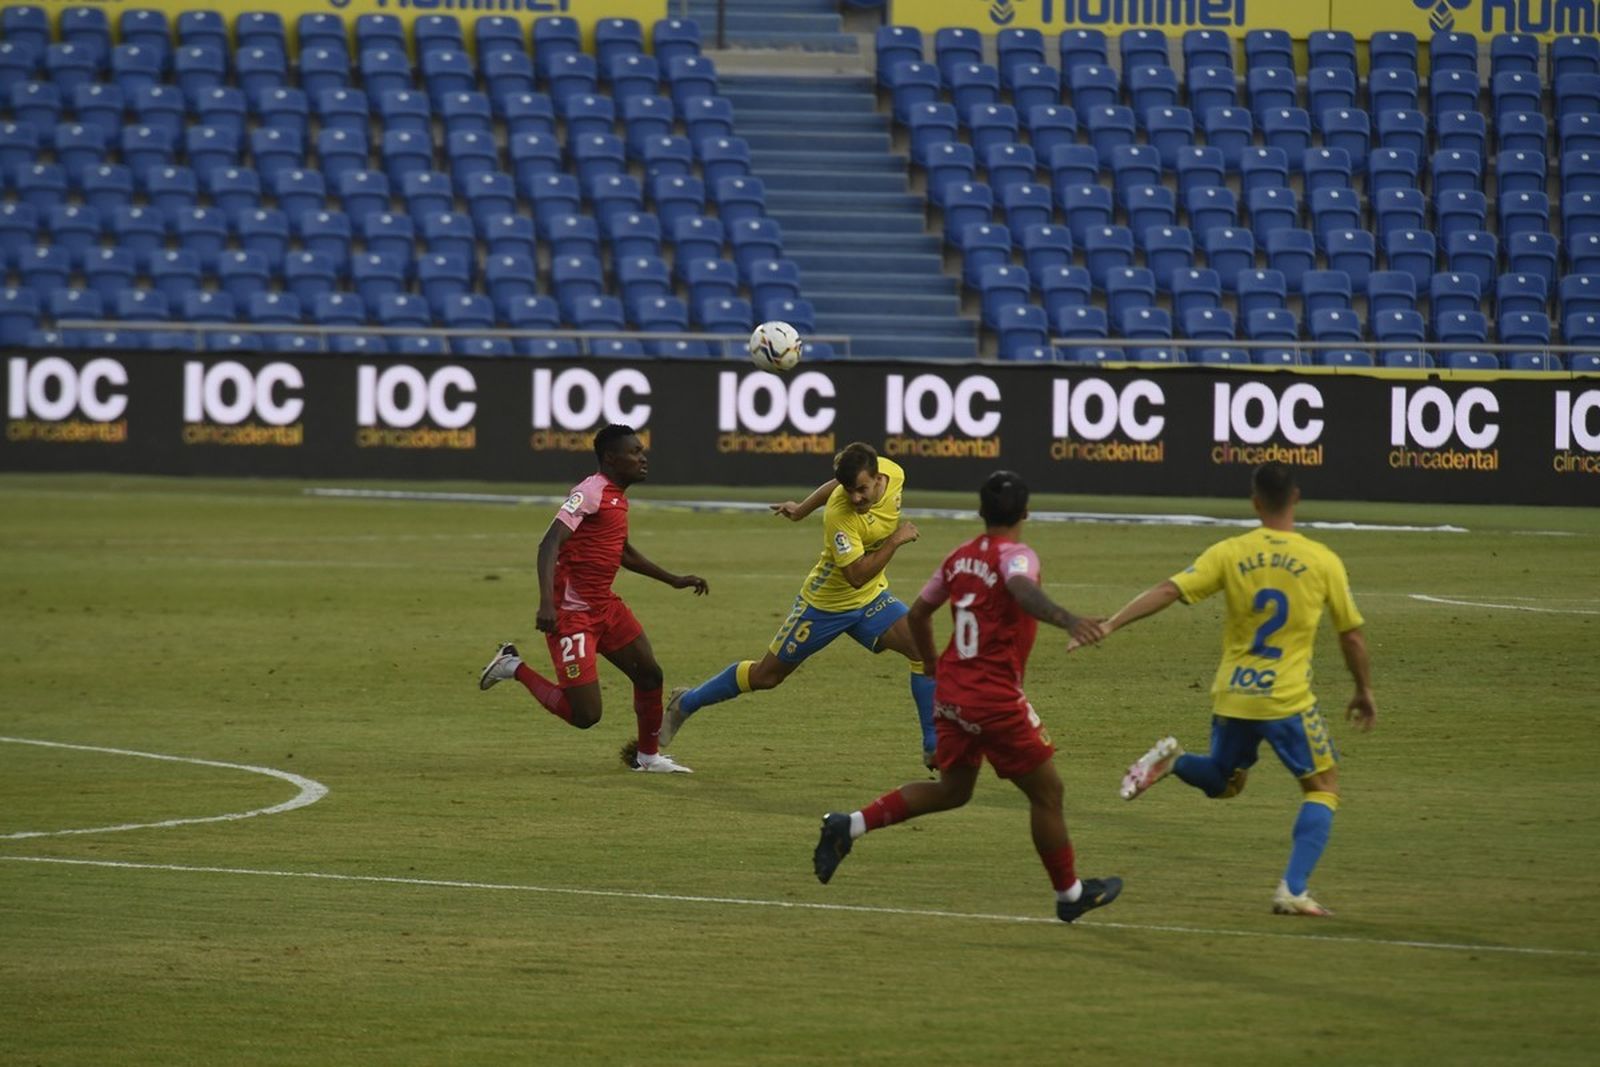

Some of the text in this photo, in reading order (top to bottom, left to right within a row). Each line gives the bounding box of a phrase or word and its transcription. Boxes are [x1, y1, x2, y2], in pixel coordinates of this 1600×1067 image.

[1481, 0, 1600, 34] hum
[9, 358, 127, 421] IOC
[184, 362, 303, 425] IOC
[358, 365, 476, 428] IOC
[532, 368, 651, 431] IOC
[719, 371, 836, 434] IOC
[886, 374, 1001, 437] IOC
[1053, 378, 1165, 440] IOC
[1214, 382, 1324, 445] IOC
[1391, 386, 1499, 449] IOC
[1212, 443, 1323, 465] clinicadental
[1389, 448, 1498, 470] clinicadental
[1238, 552, 1266, 576] ALE
[560, 632, 586, 663] 27
[795, 620, 813, 643] 6
[956, 593, 980, 660] 6
[1251, 588, 1289, 659] 2
[1229, 665, 1276, 689] IOC
